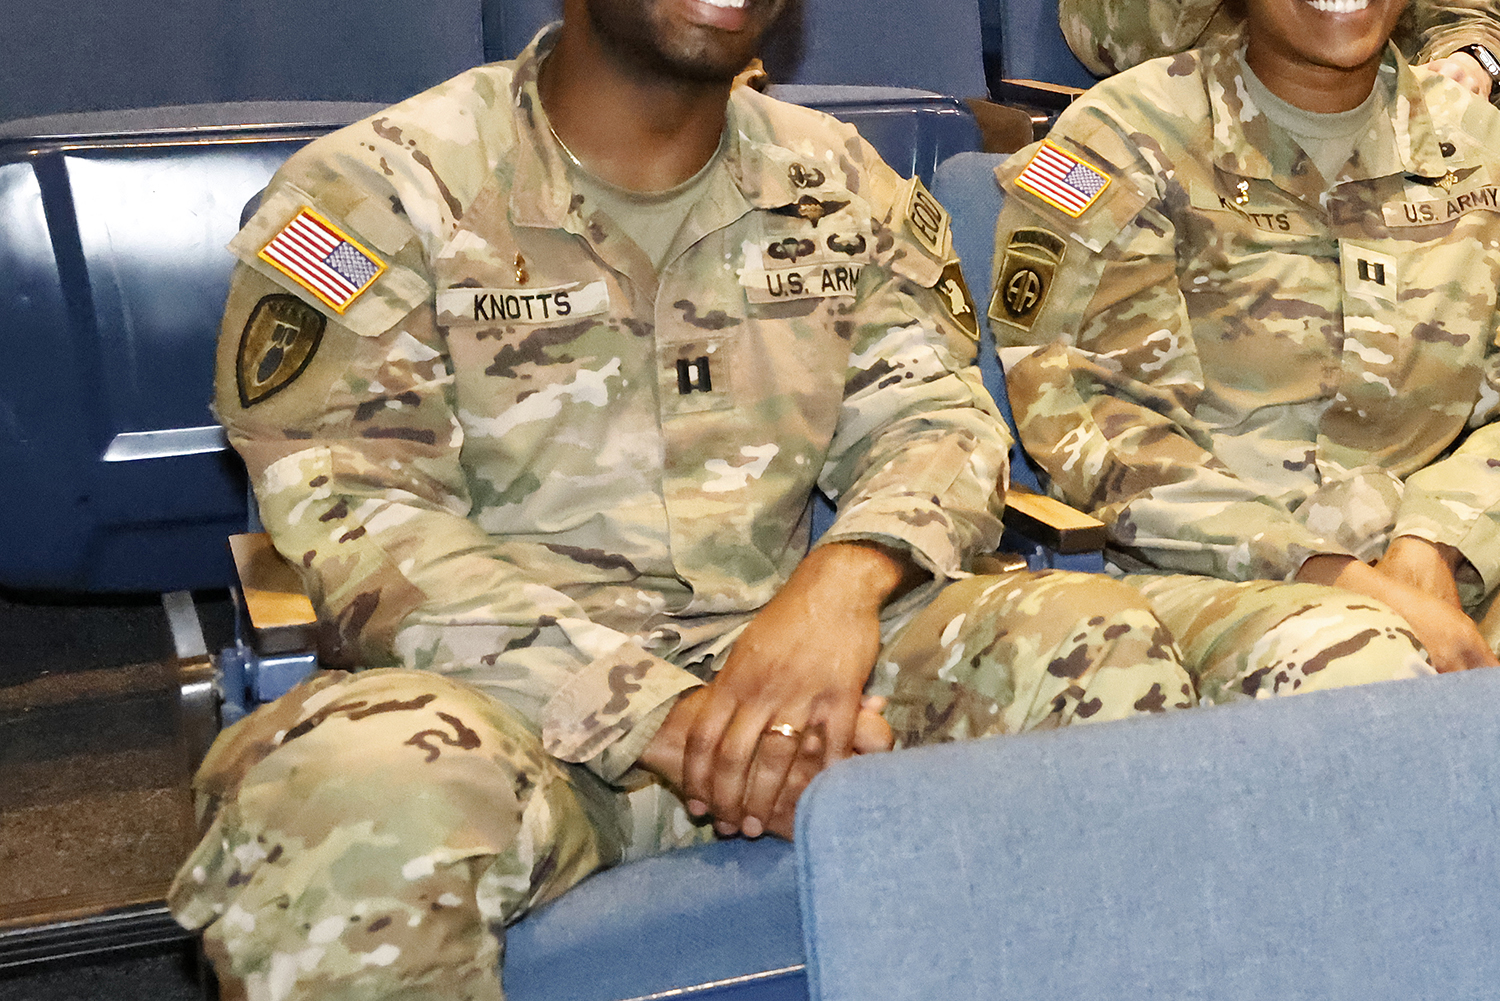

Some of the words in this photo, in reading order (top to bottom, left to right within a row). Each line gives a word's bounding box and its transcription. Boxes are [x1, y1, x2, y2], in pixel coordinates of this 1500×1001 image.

[911, 192, 942, 247] EOD
[1403, 203, 1438, 224] U.S.
[1446, 188, 1498, 218] ARMY
[766, 272, 809, 297] U.S.
[474, 291, 571, 320] KNOTTS
